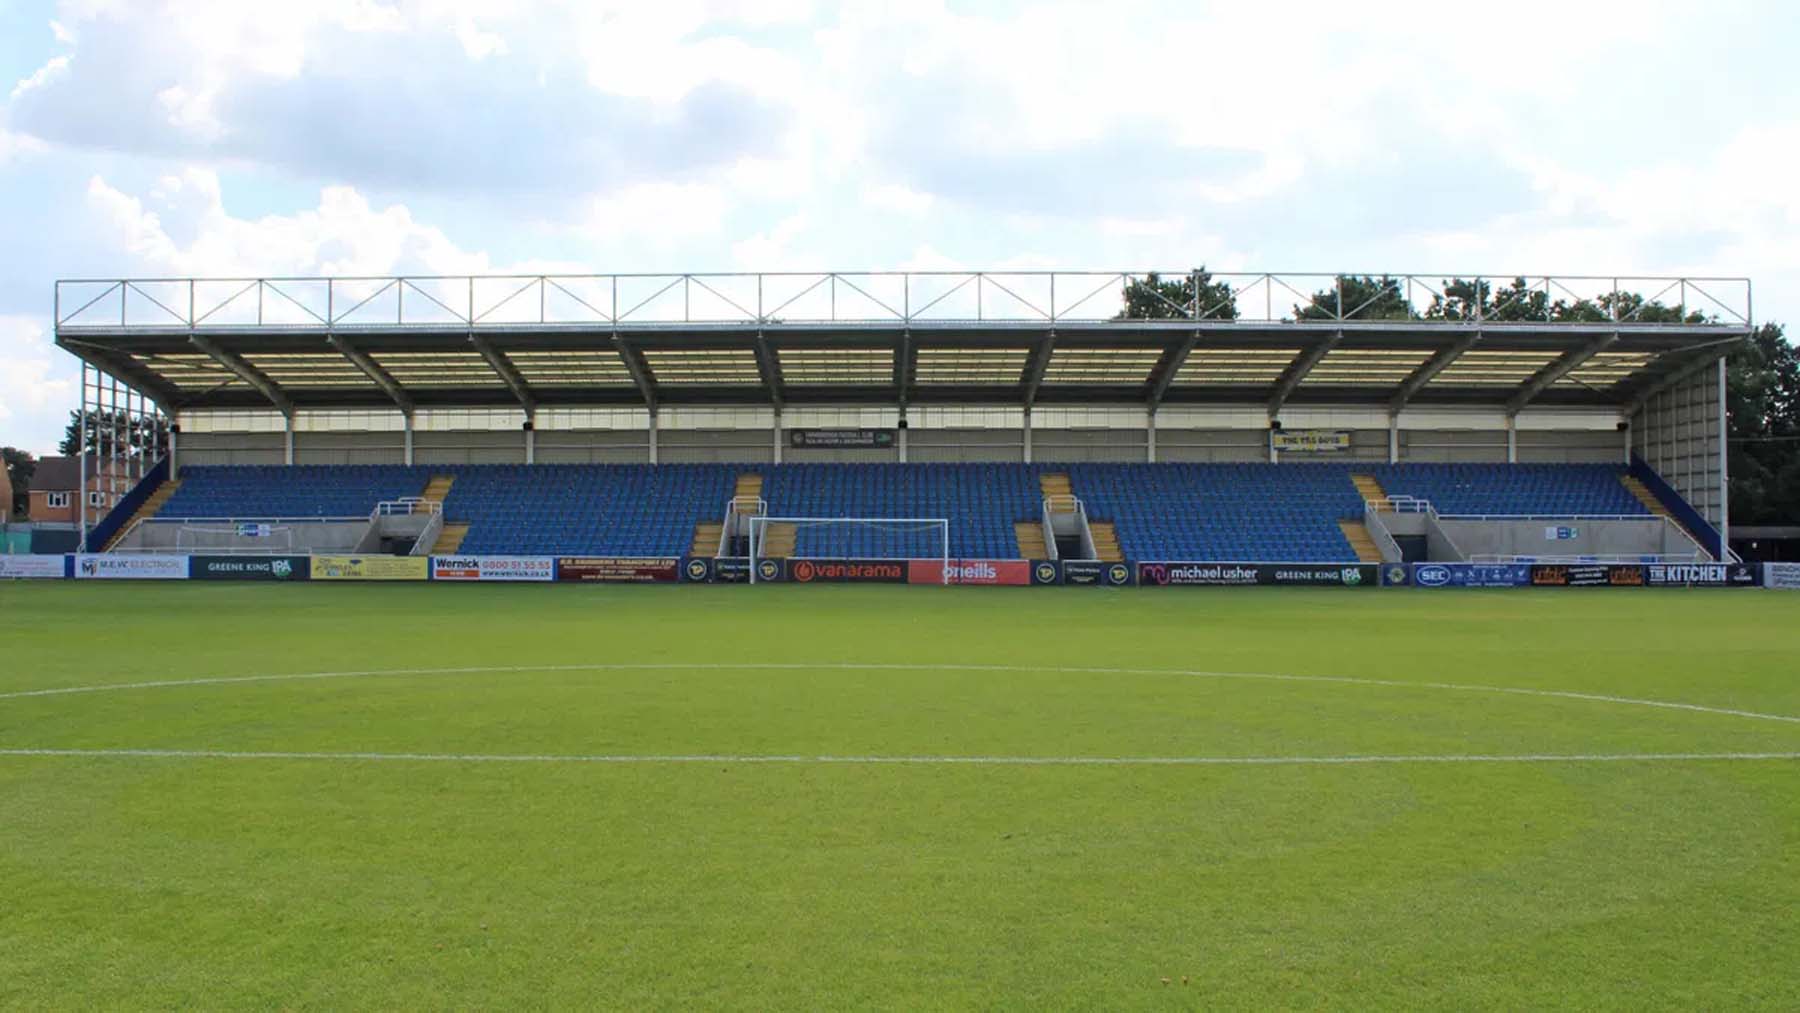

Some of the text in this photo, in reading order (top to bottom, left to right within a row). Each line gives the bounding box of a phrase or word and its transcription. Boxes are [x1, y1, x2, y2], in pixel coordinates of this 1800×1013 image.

[208, 560, 292, 573] GREENE KING IPA
[436, 559, 479, 569] Wernick
[816, 563, 902, 577] vanarama
[1171, 566, 1258, 579] michael usher
[1275, 568, 1361, 581] GREENE KING IPA
[1421, 569, 1446, 581] SEC
[1650, 569, 1666, 578] THE
[1667, 565, 1727, 581] KITCHEN
